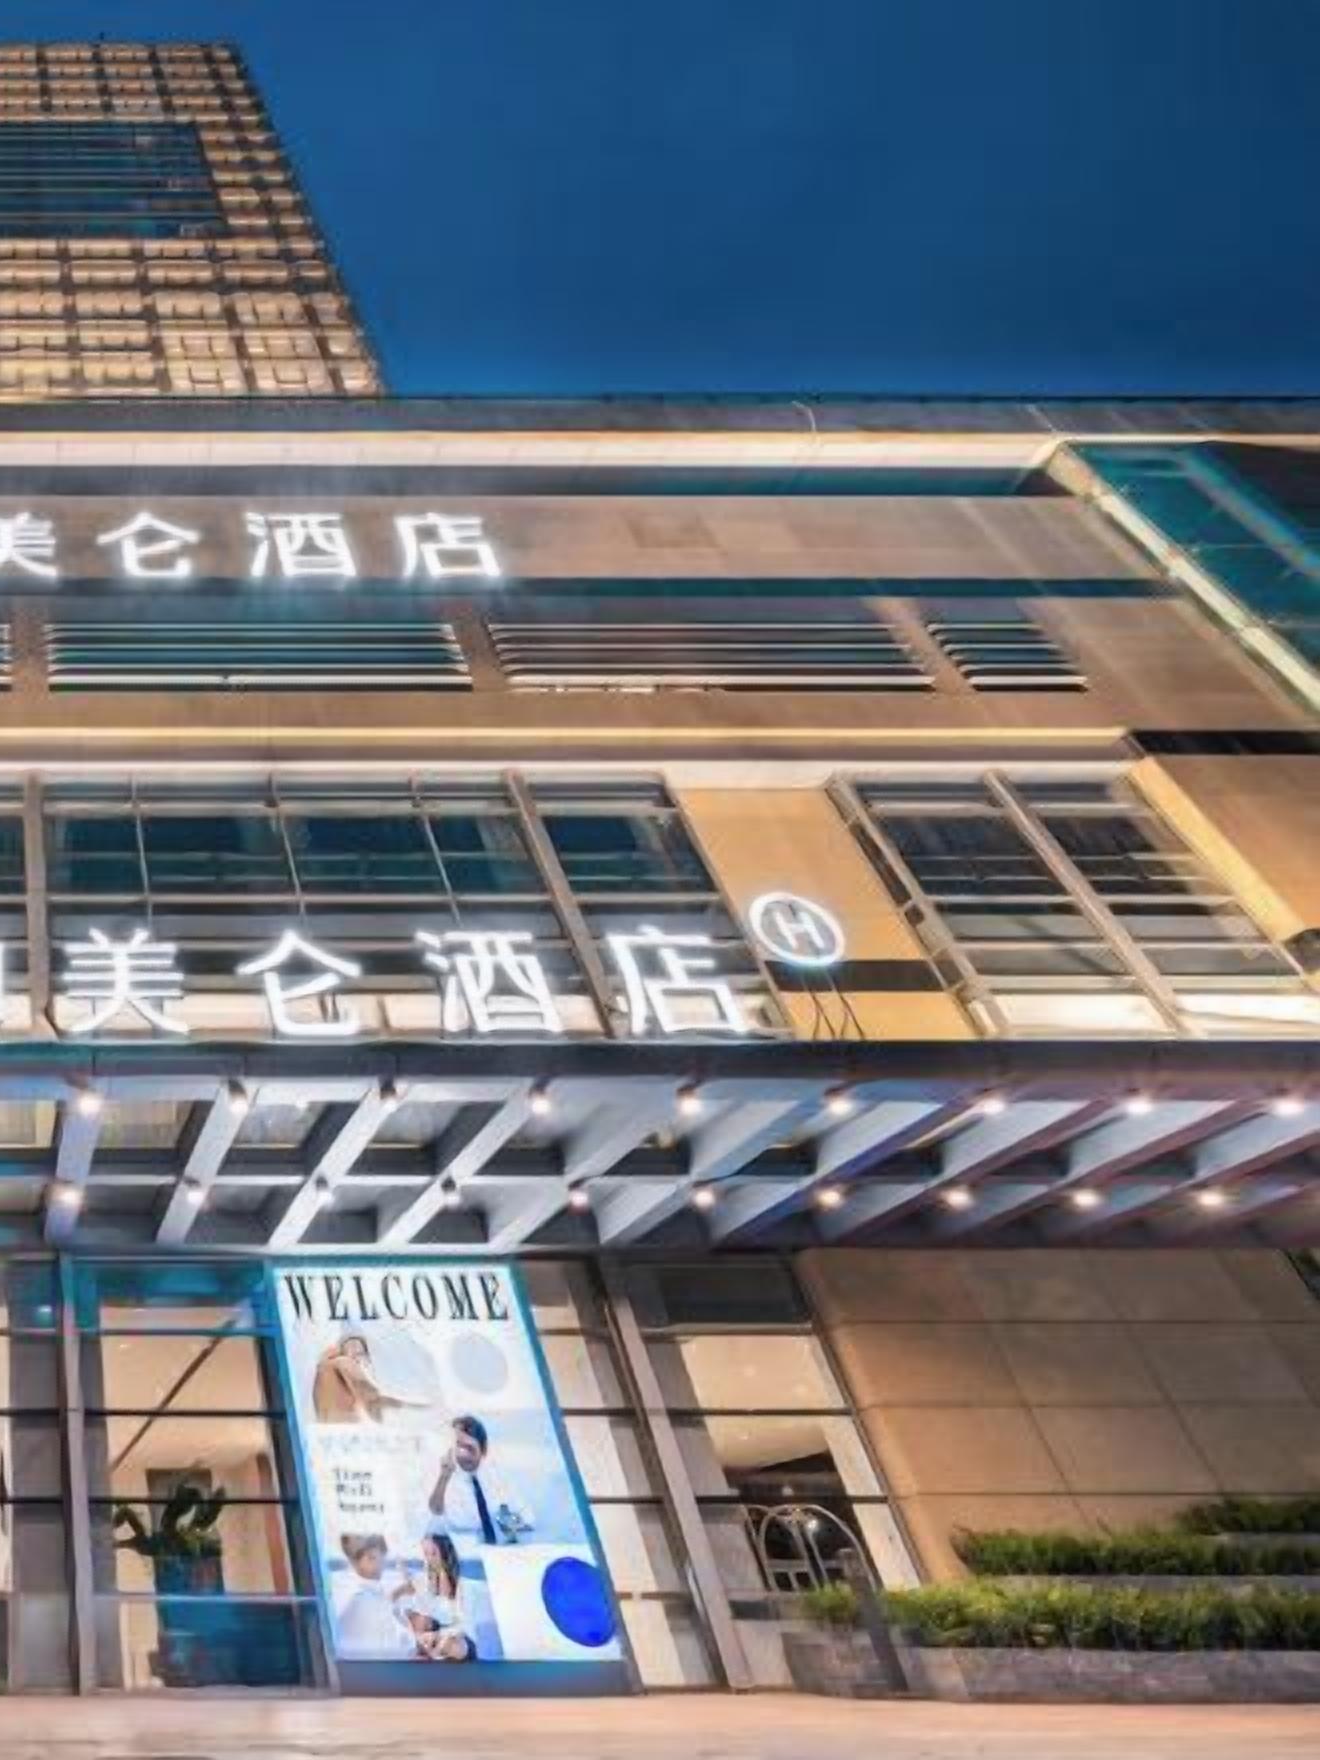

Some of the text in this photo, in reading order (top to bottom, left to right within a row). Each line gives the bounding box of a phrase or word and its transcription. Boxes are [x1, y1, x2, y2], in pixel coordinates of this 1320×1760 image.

[61, 926, 751, 1036] 美仑酒店
[284, 1270, 509, 1322] WELCOME
